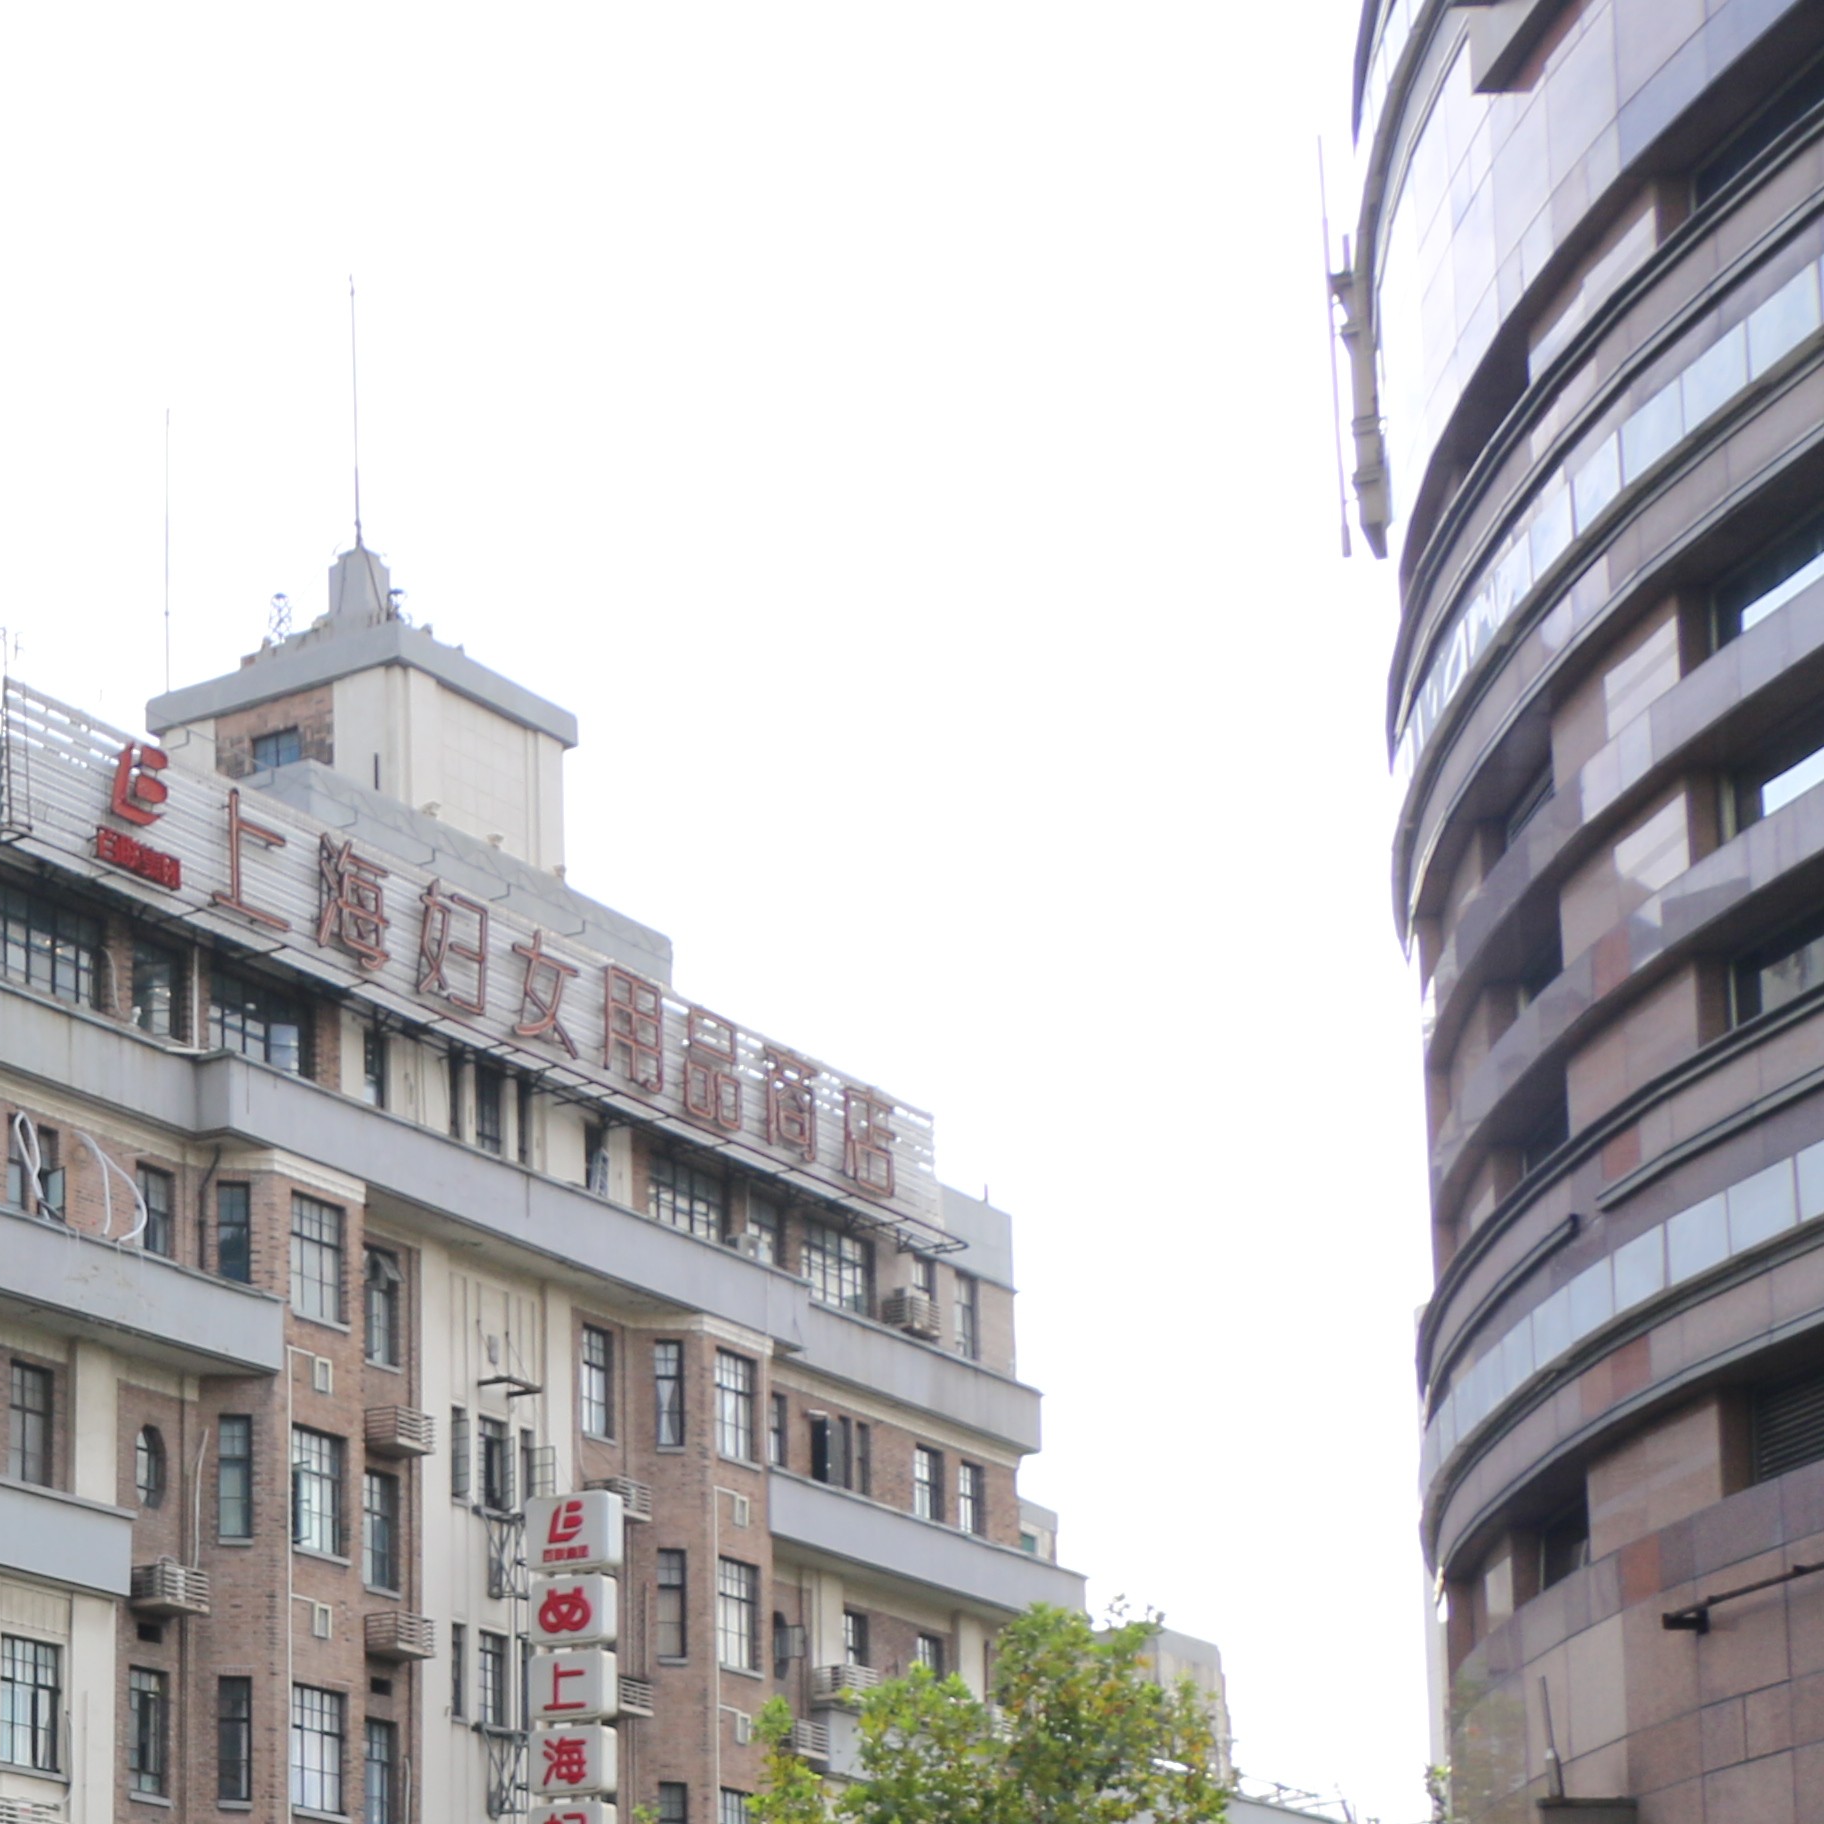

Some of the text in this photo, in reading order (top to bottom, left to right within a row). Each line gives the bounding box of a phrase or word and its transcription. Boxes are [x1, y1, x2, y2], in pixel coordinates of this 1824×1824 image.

[211, 787, 896, 1197] 上海妇女用品商店
